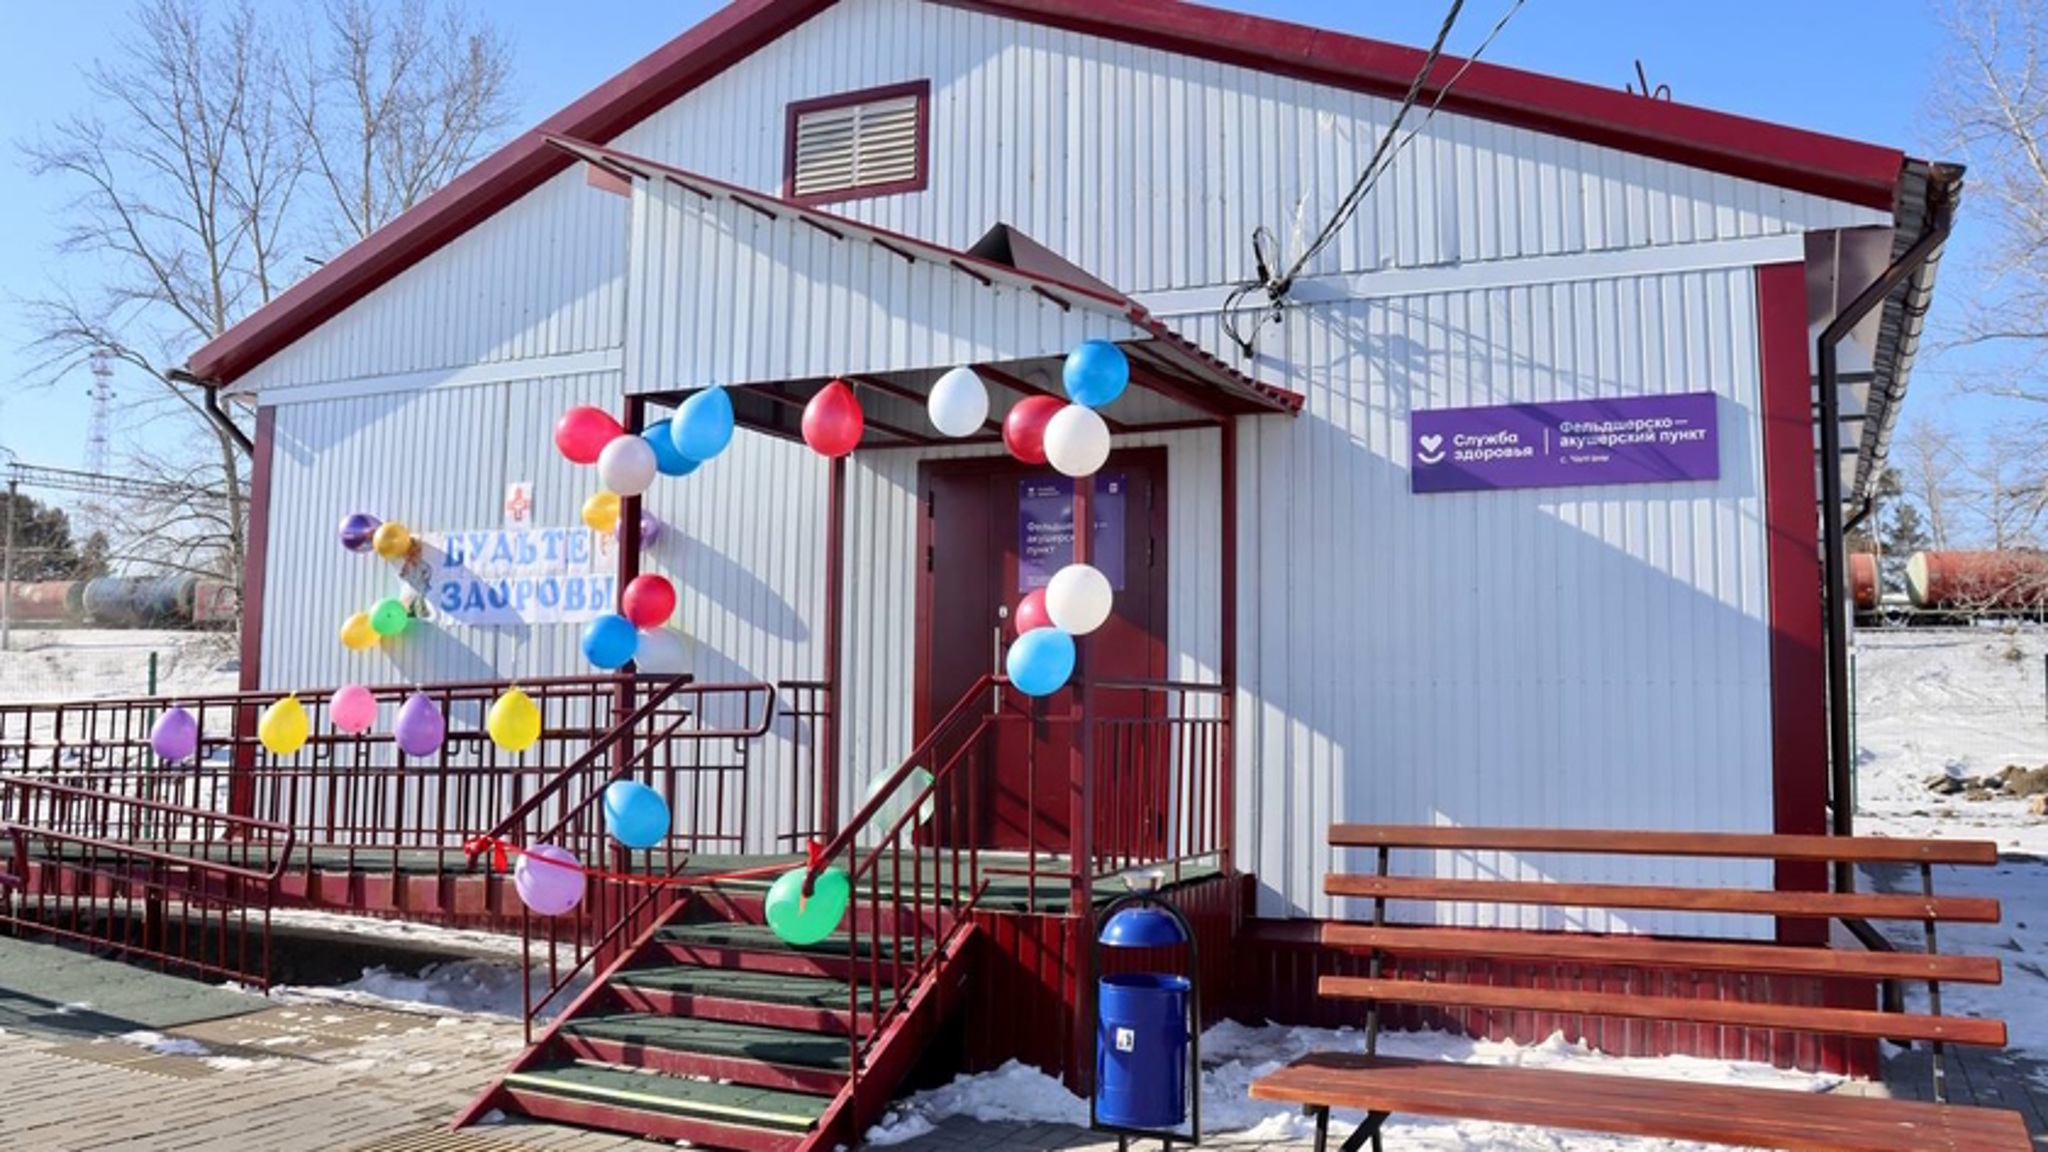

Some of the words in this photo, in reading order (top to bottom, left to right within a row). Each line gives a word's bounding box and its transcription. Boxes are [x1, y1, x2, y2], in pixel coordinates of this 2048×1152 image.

[1453, 430, 1519, 447] Служба
[1559, 428, 1657, 449] акушерский
[1659, 429, 1707, 445] пункт
[1454, 446, 1534, 462] здоровья
[443, 530, 590, 568] БУДЬТЕ
[440, 575, 615, 611] ЗДОРОВЫ
